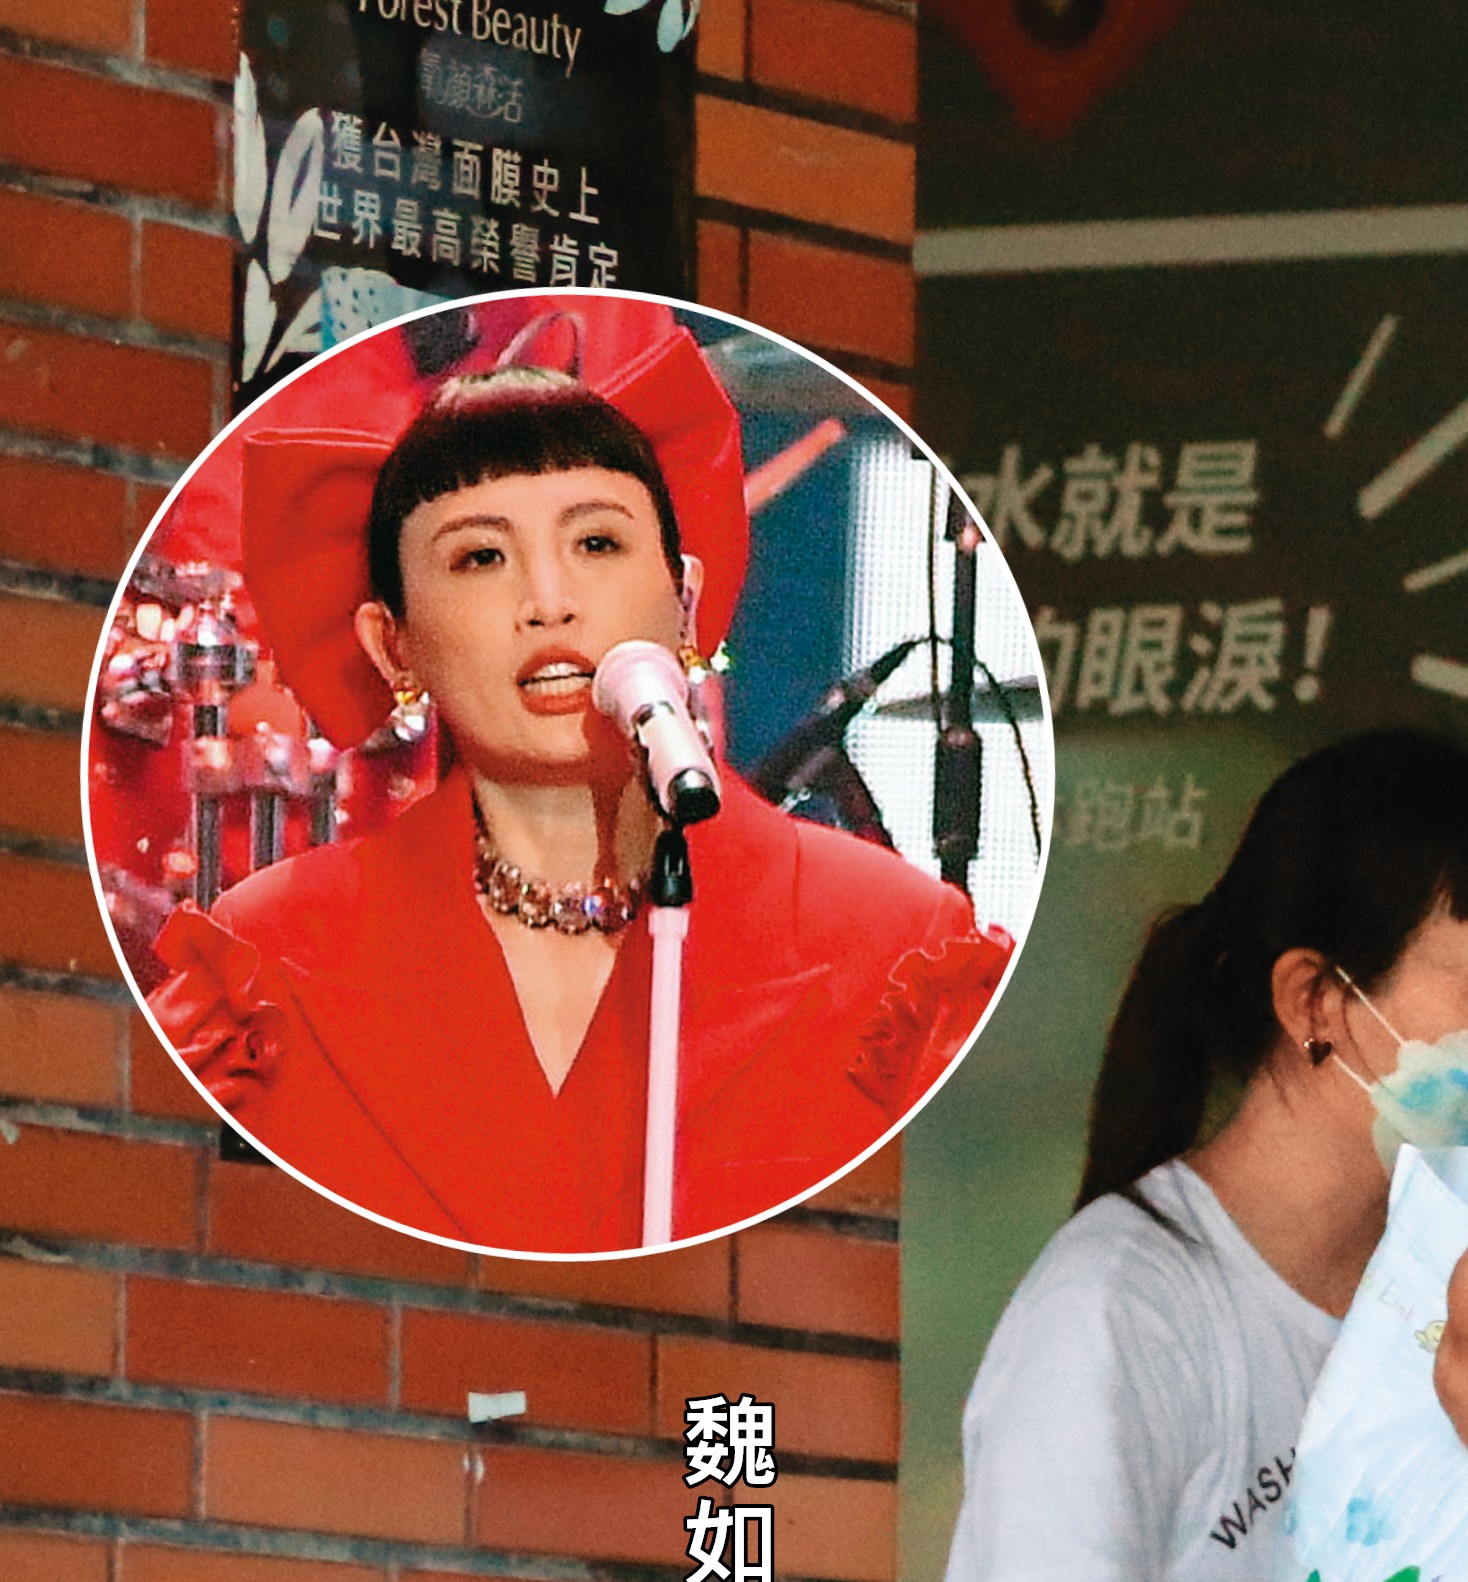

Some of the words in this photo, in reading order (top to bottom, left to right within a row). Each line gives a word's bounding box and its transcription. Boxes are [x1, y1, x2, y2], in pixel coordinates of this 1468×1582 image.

[471, 0, 582, 79] Beauty
[331, 110, 600, 225] 獲台灣面膜史上
[313, 181, 618, 288] 世界最高榮譽肯定
